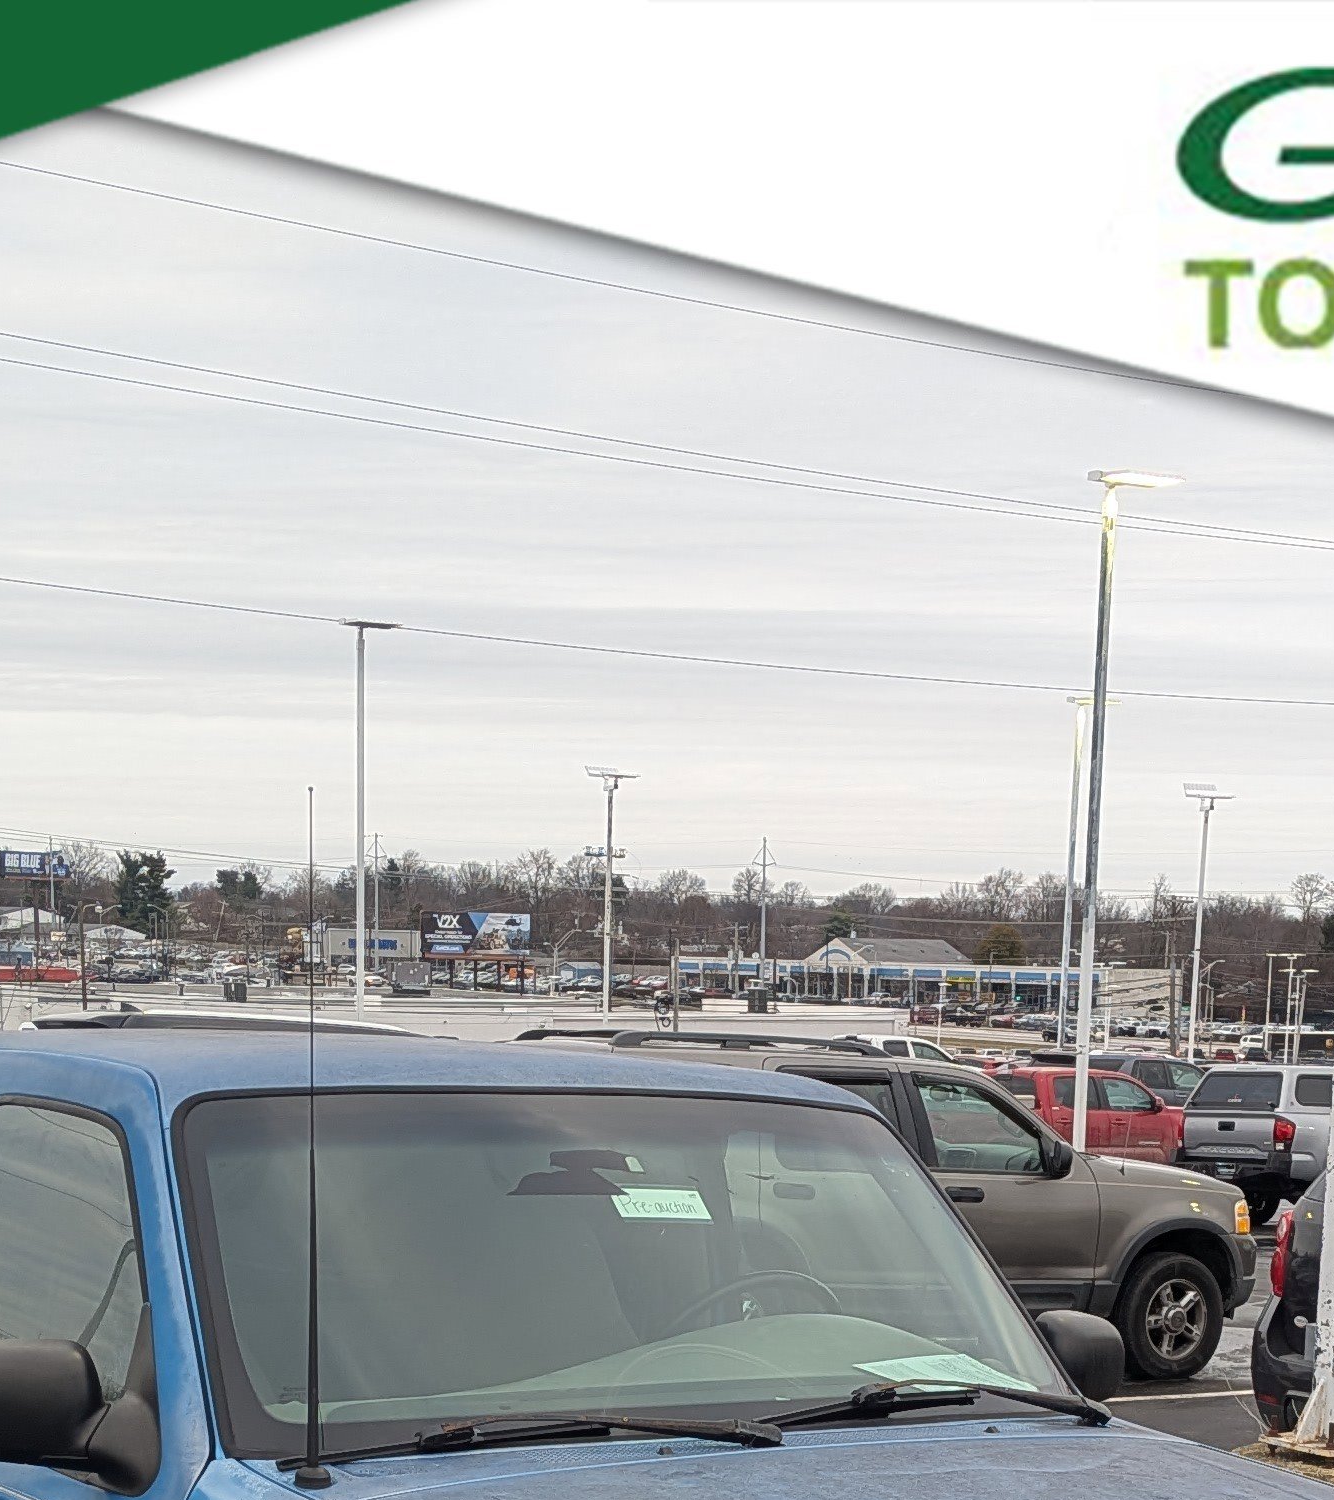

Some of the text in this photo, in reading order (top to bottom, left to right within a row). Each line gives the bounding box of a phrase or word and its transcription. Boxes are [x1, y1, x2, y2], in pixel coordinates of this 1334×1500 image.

[5, 853, 42, 869] BIG BLUE
[432, 913, 462, 928] V2X
